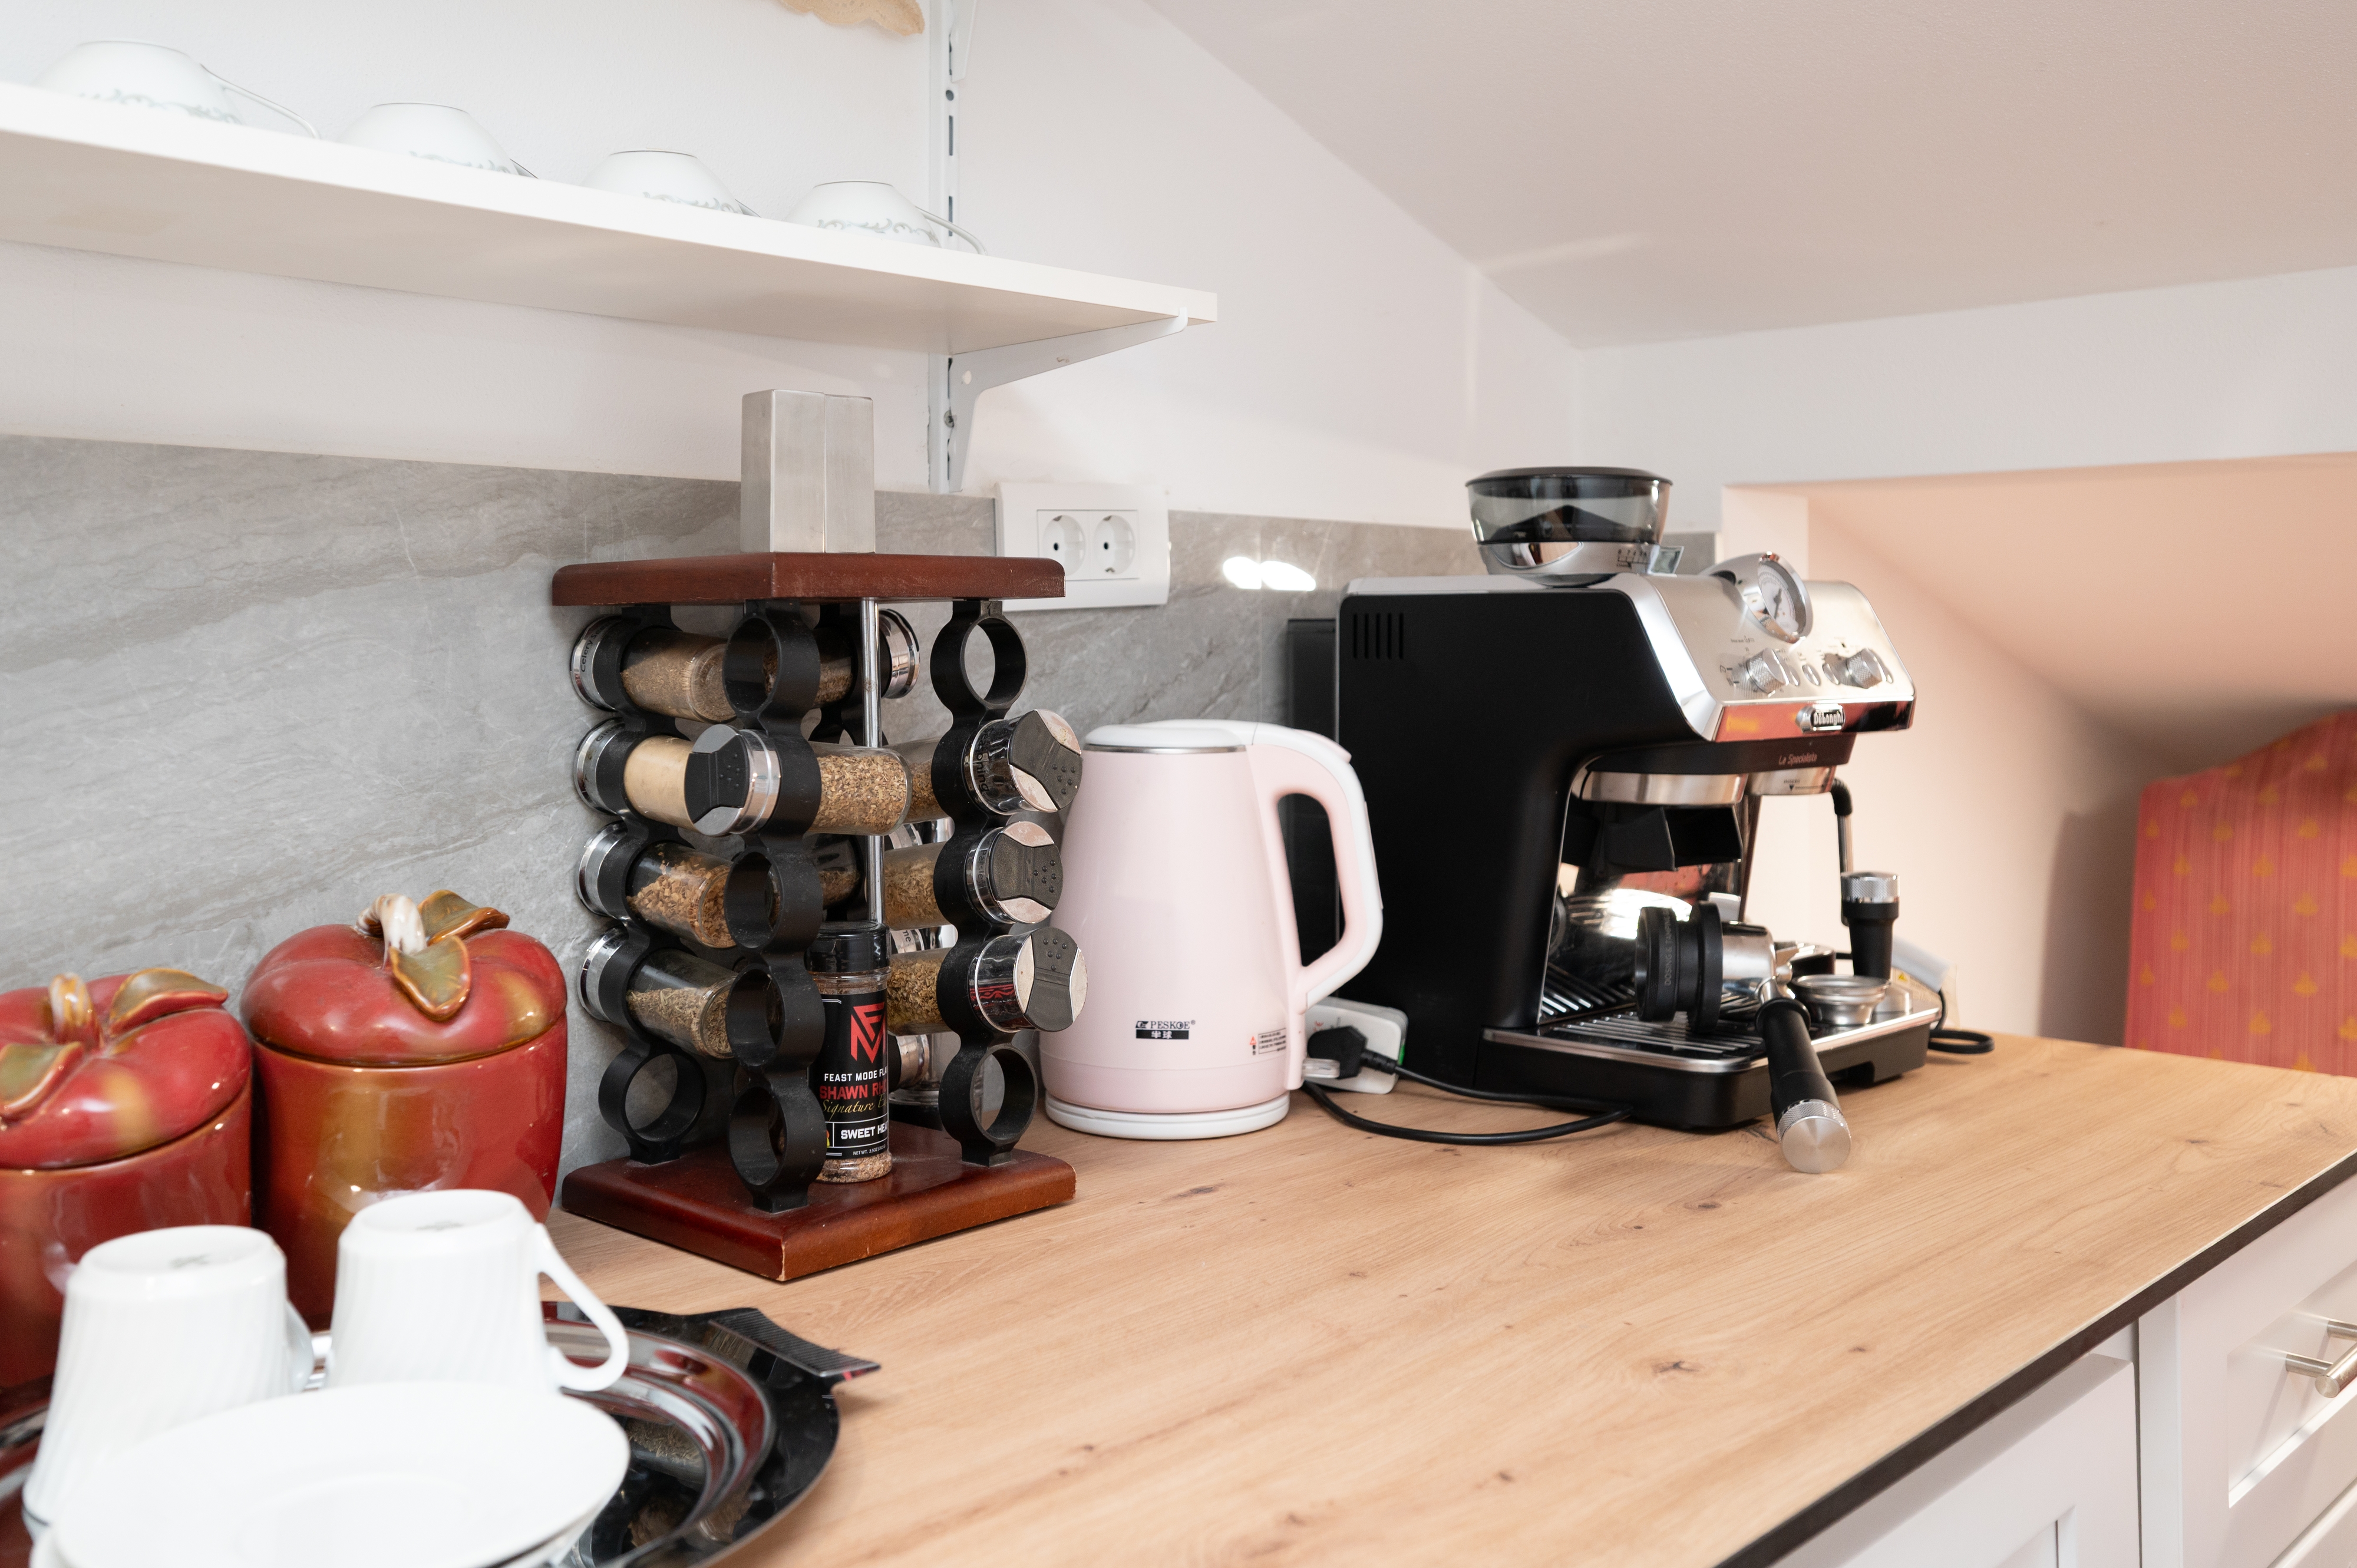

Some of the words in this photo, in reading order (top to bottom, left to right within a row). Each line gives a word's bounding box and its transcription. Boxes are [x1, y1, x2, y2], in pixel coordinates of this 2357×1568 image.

[580, 640, 593, 672] Celery
[1778, 755, 1787, 765] La
[824, 1073, 853, 1082] FEAST
[856, 1069, 877, 1081] MODE
[879, 1065, 888, 1077] FLA
[819, 1084, 868, 1100] SHAWN
[823, 1100, 876, 1124] Signature
[840, 1125, 876, 1140] SWEET
[877, 1121, 888, 1135] HEA
